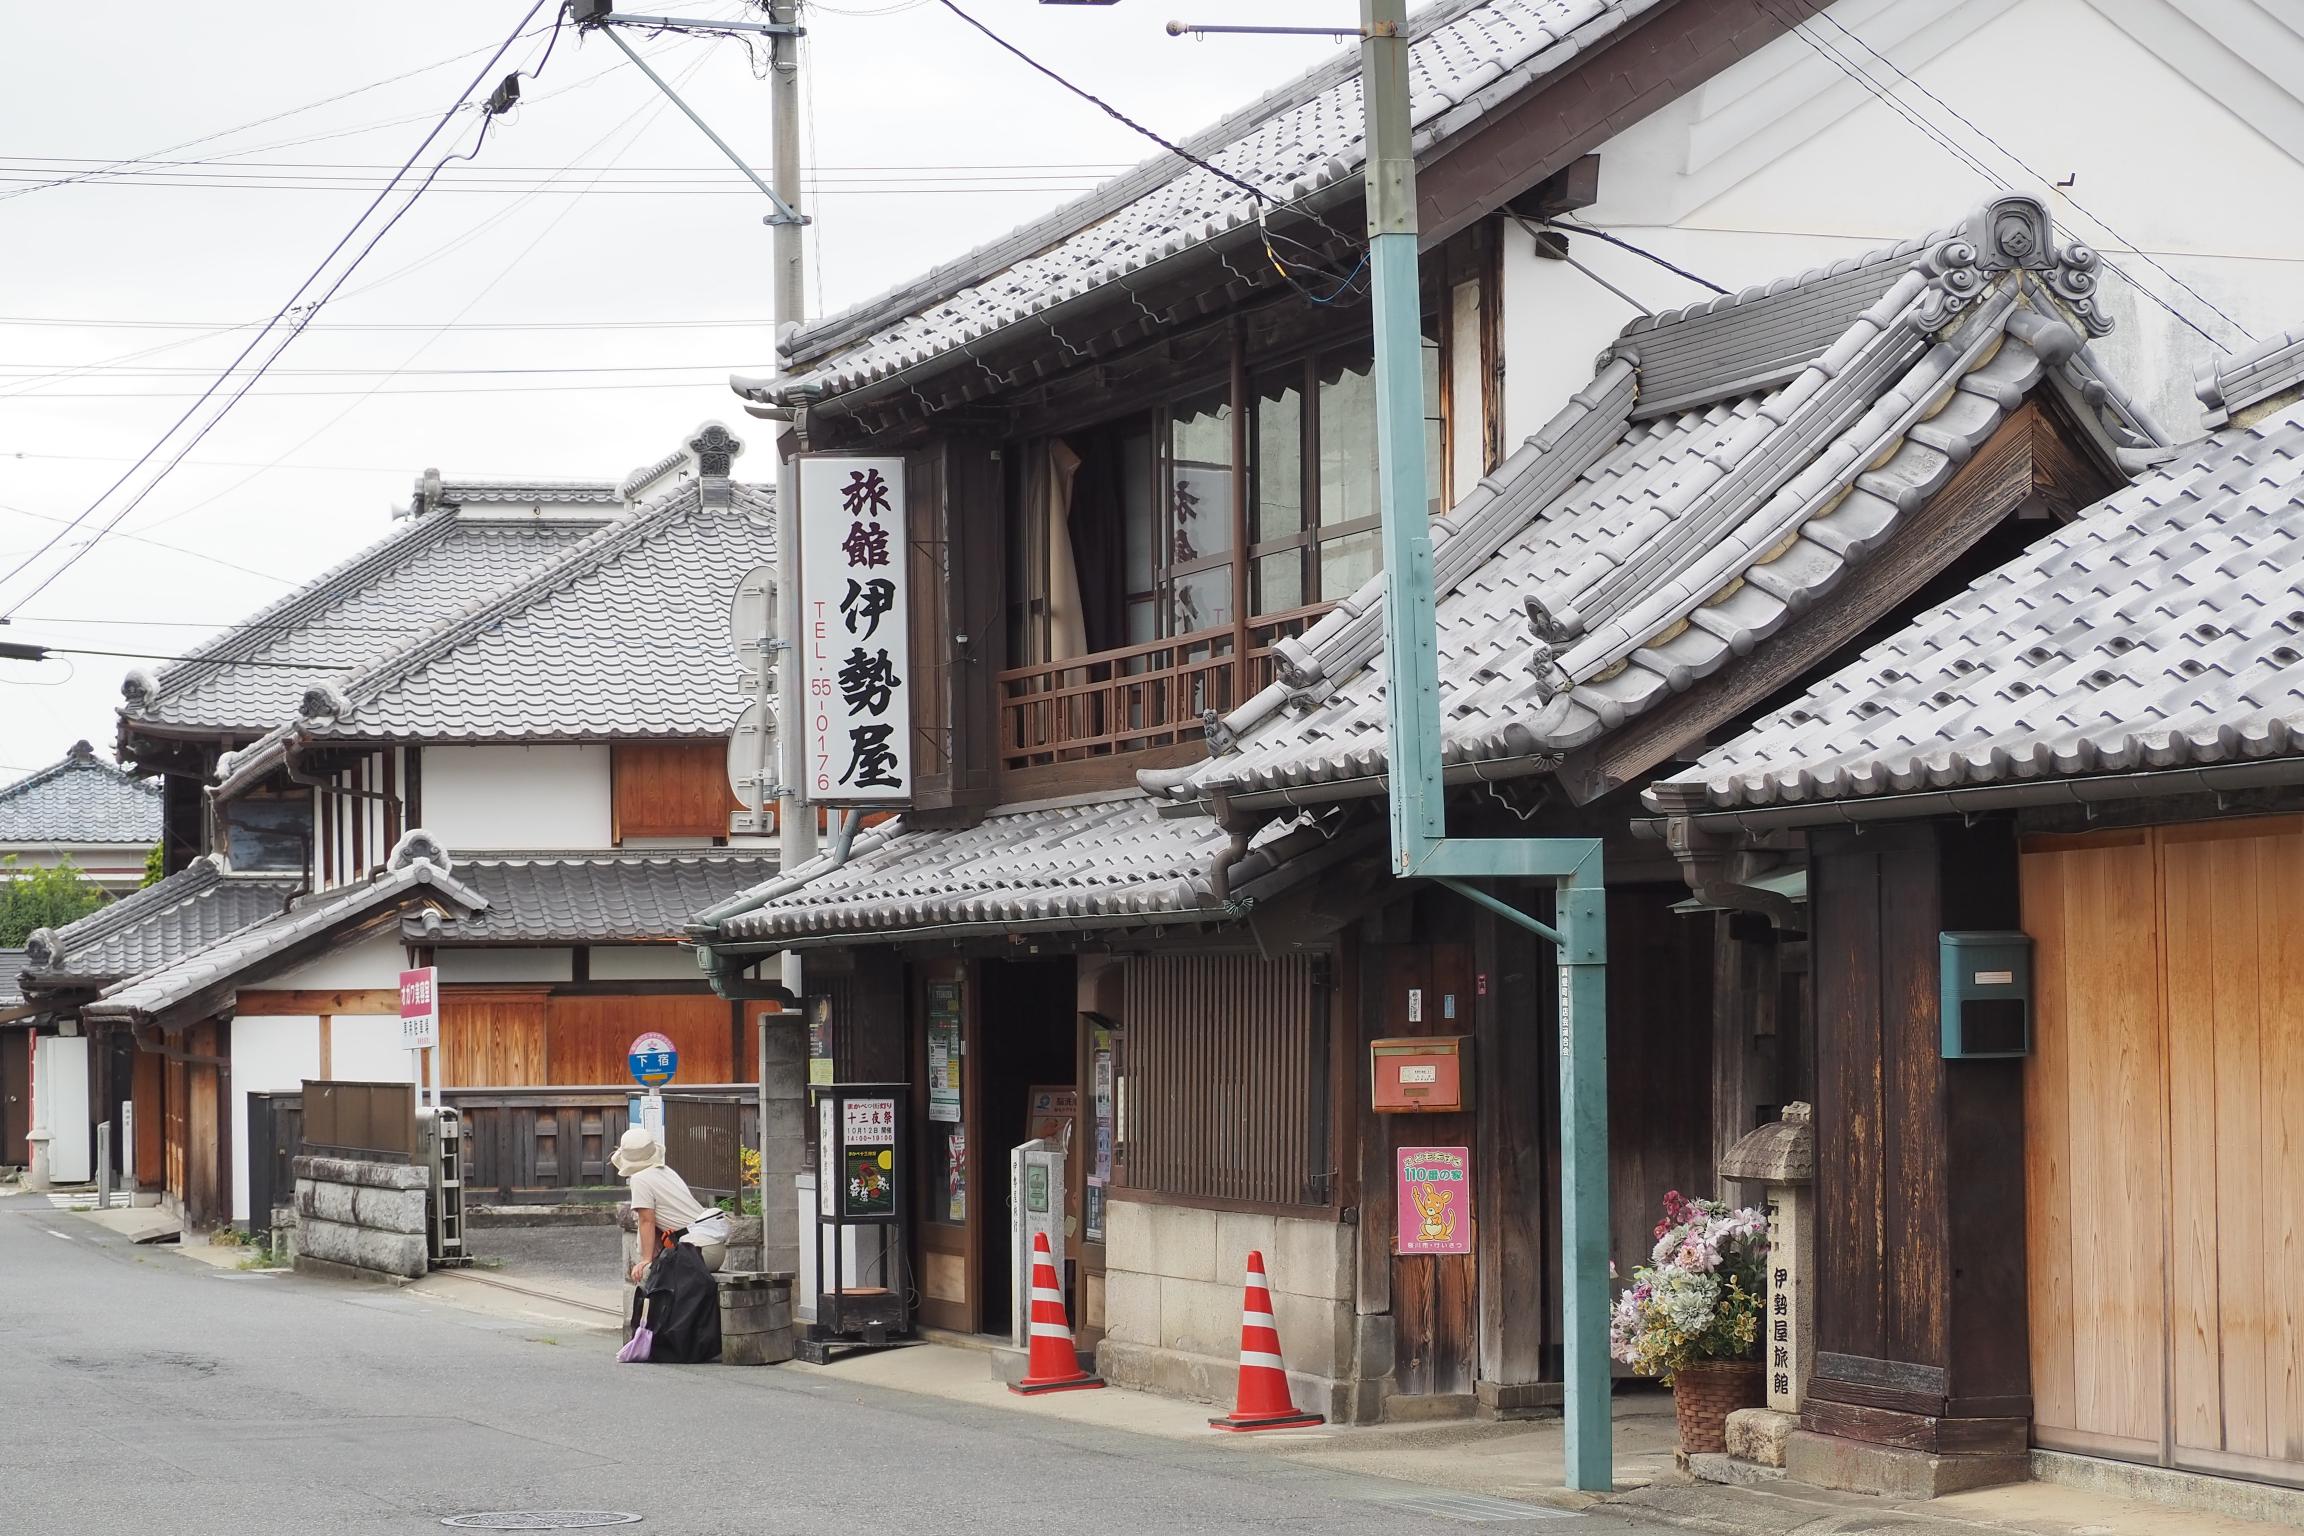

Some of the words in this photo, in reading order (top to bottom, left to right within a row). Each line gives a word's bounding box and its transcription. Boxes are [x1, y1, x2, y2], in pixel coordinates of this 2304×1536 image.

[838, 468, 902, 789] 旅館伊勢屋
[848, 1110, 892, 1124] 十三夜祭
[1404, 1167, 1464, 1182] 110番の家
[1773, 1266, 1789, 1396] 伊勢屋旅館
